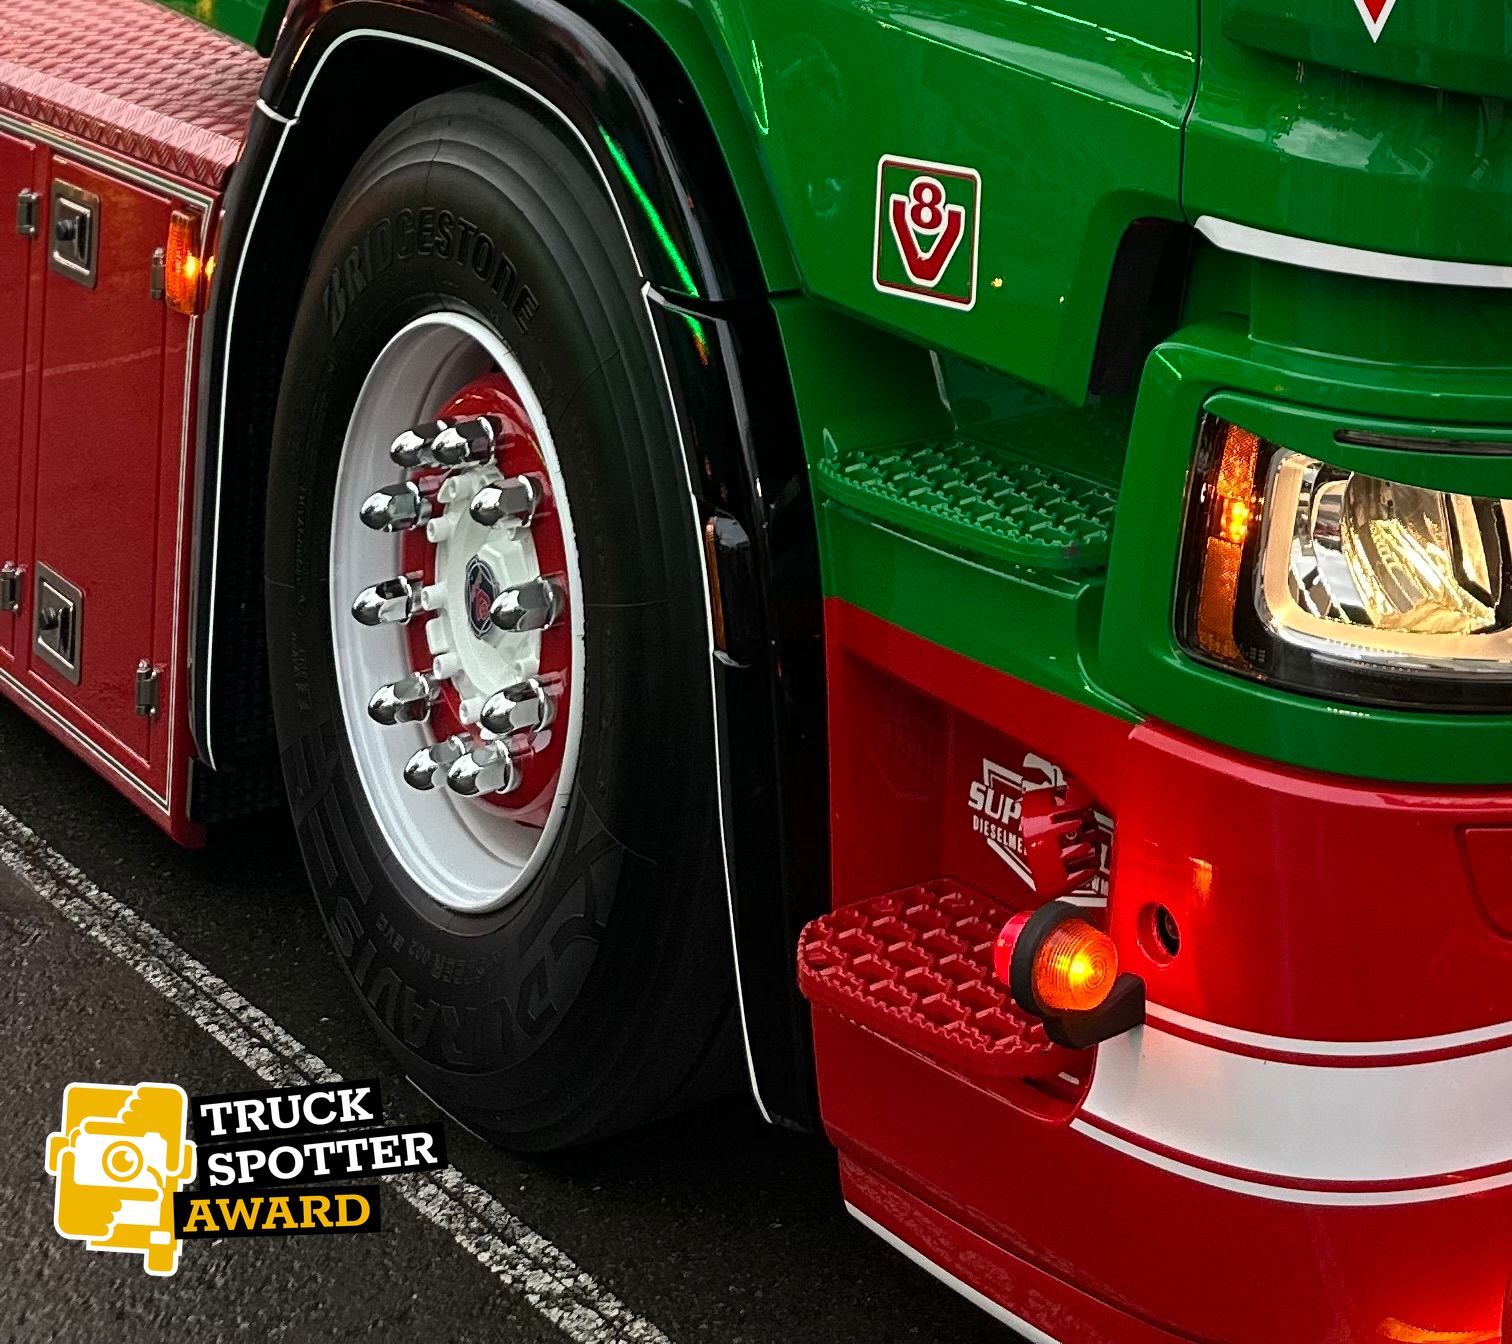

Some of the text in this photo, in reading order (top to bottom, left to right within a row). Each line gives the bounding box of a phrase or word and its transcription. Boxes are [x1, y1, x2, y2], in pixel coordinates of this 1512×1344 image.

[323, 206, 541, 336] BRIDGESTONE
[967, 780, 1024, 828] SUP
[972, 814, 1028, 856] DIESELME
